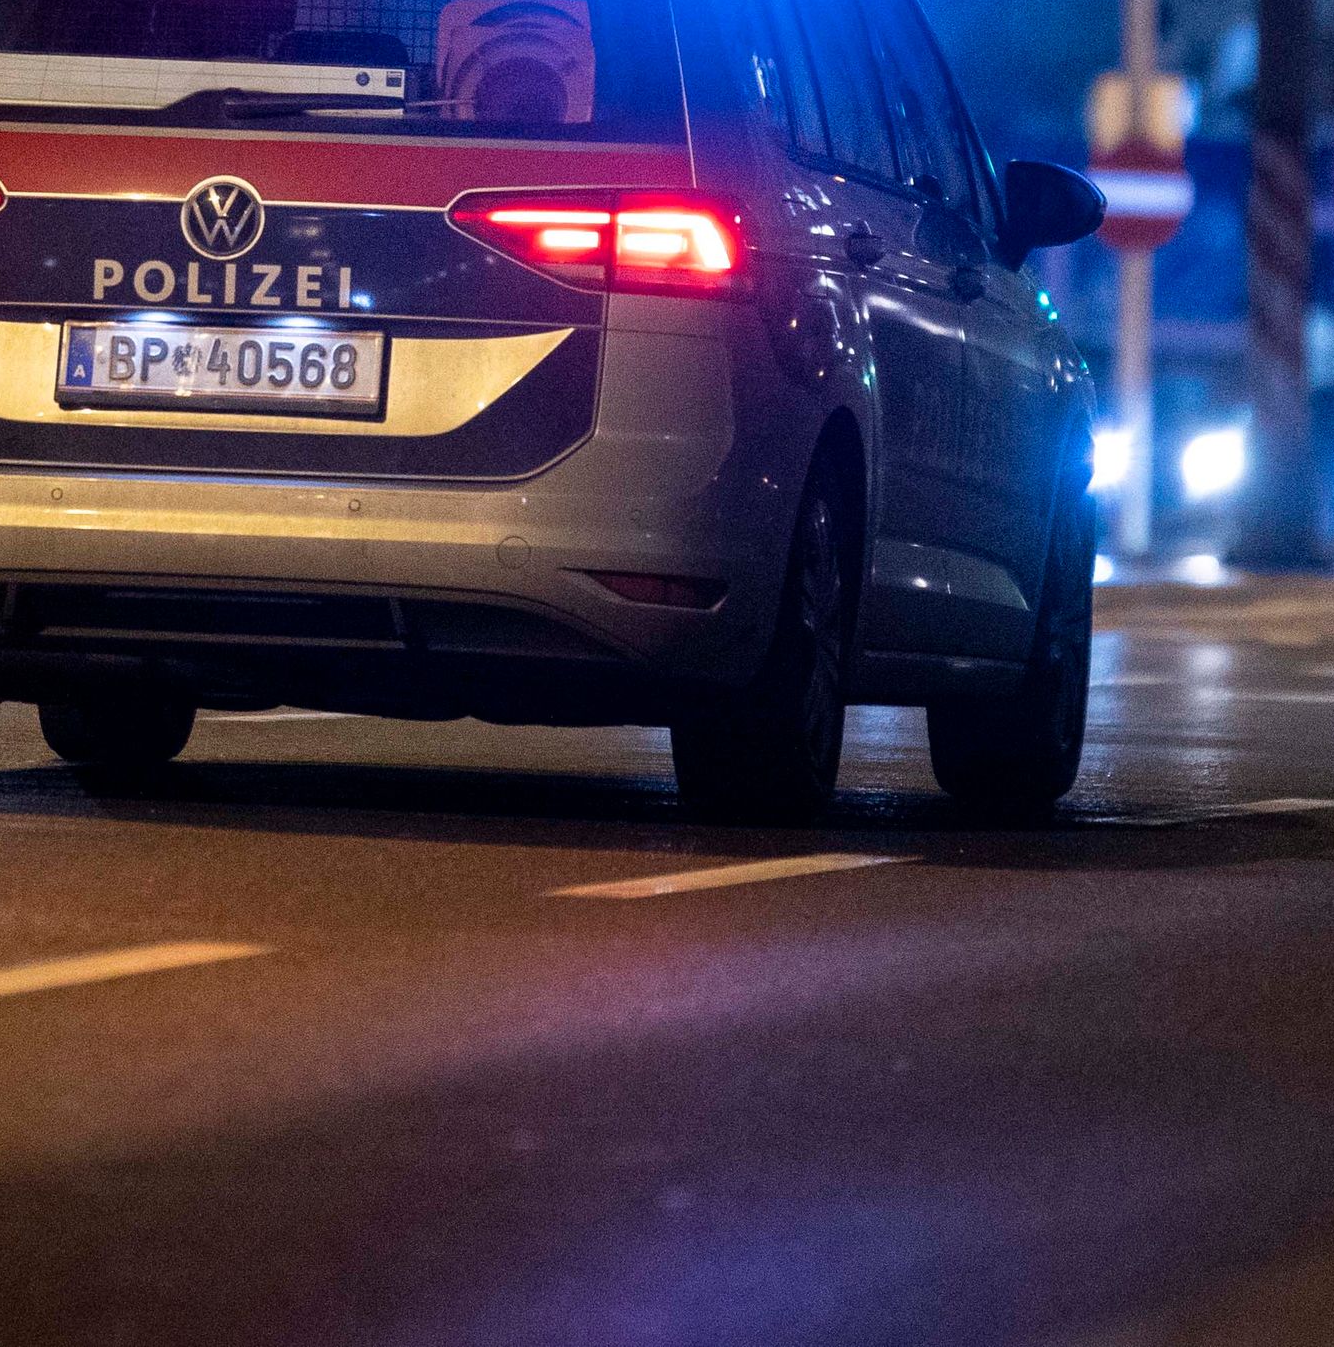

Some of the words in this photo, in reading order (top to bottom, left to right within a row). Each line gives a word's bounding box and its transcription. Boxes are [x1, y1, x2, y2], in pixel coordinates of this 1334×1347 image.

[93, 258, 352, 309] POLIZEI
[73, 363, 86, 379] A
[108, 335, 168, 382] BP
[206, 338, 358, 391] 40568
